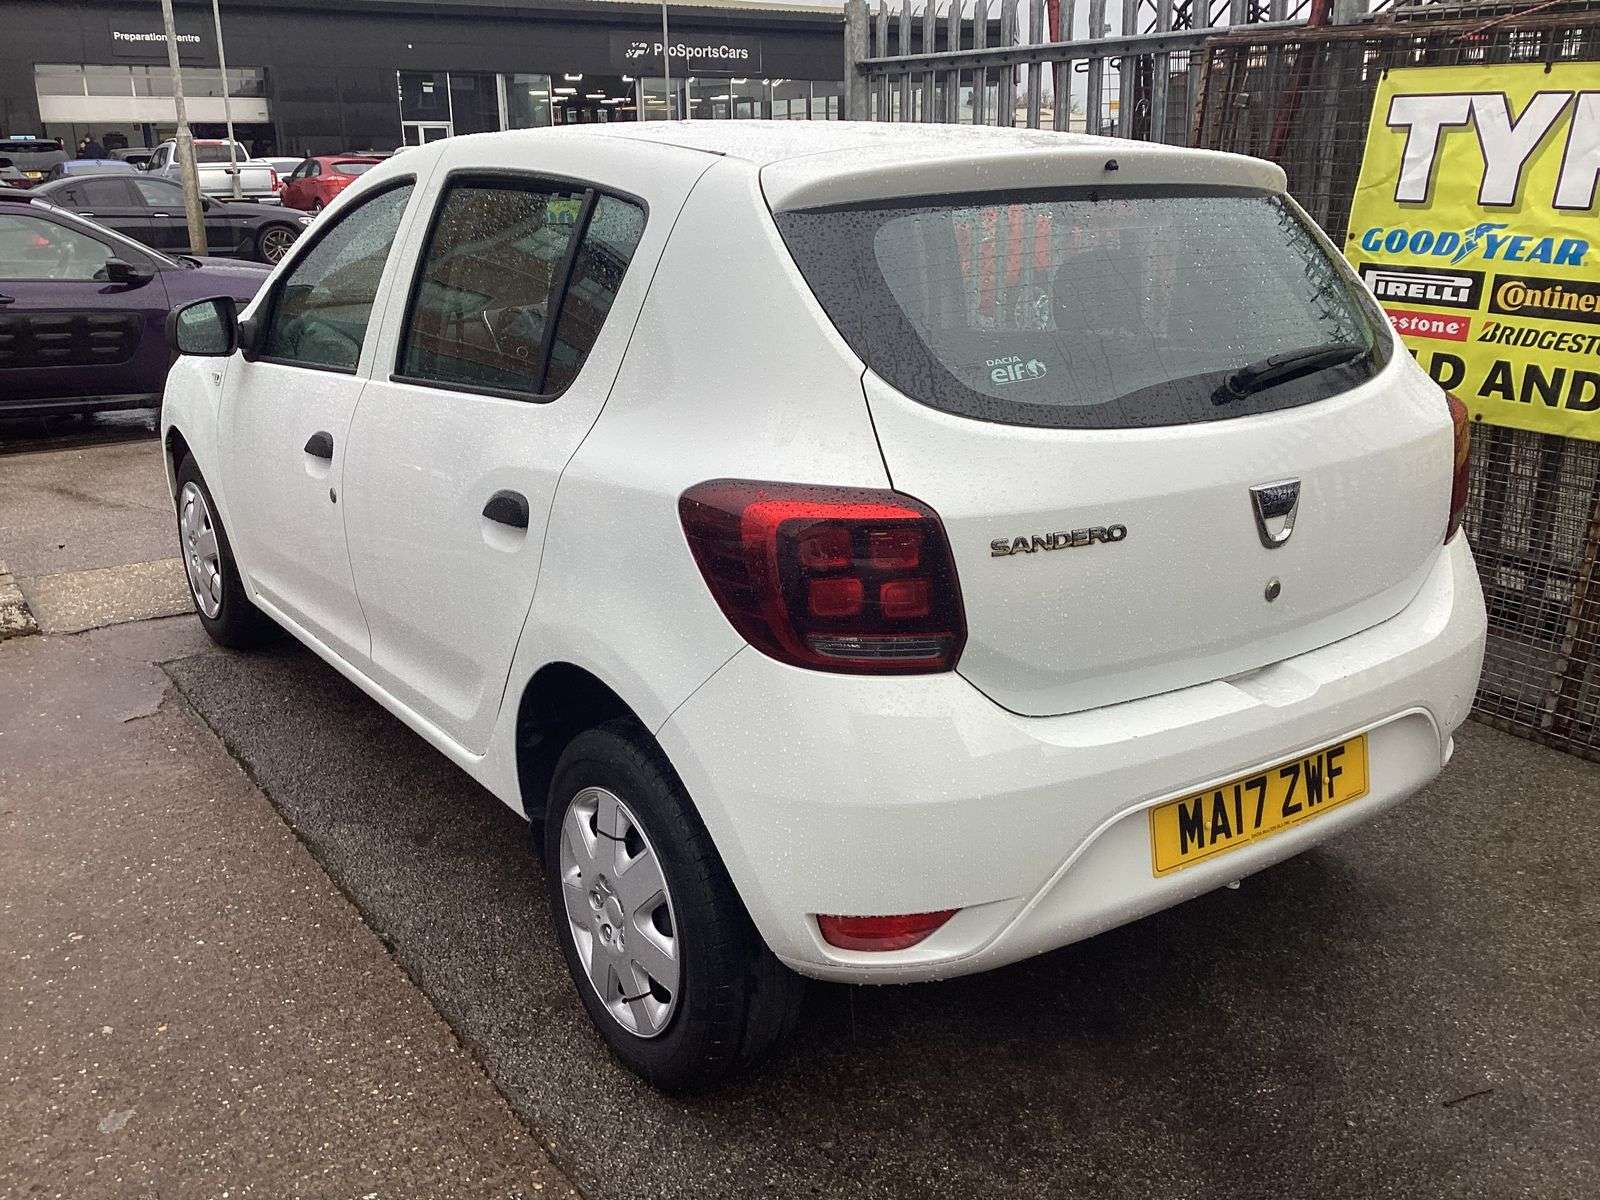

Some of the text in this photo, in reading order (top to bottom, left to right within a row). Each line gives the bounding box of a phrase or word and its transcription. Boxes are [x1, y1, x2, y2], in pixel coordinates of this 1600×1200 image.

[113, 31, 200, 43] Preparation entre
[654, 43, 749, 60] PoSportsCars
[1364, 269, 1474, 303] PIRELLI
[1389, 315, 1460, 335] estone
[985, 355, 1022, 367] DACIA
[991, 363, 1025, 383] elf
[1477, 359, 1600, 412] AND
[990, 523, 1128, 558] SANDERO
[1177, 745, 1346, 856] MA17 ZWF
